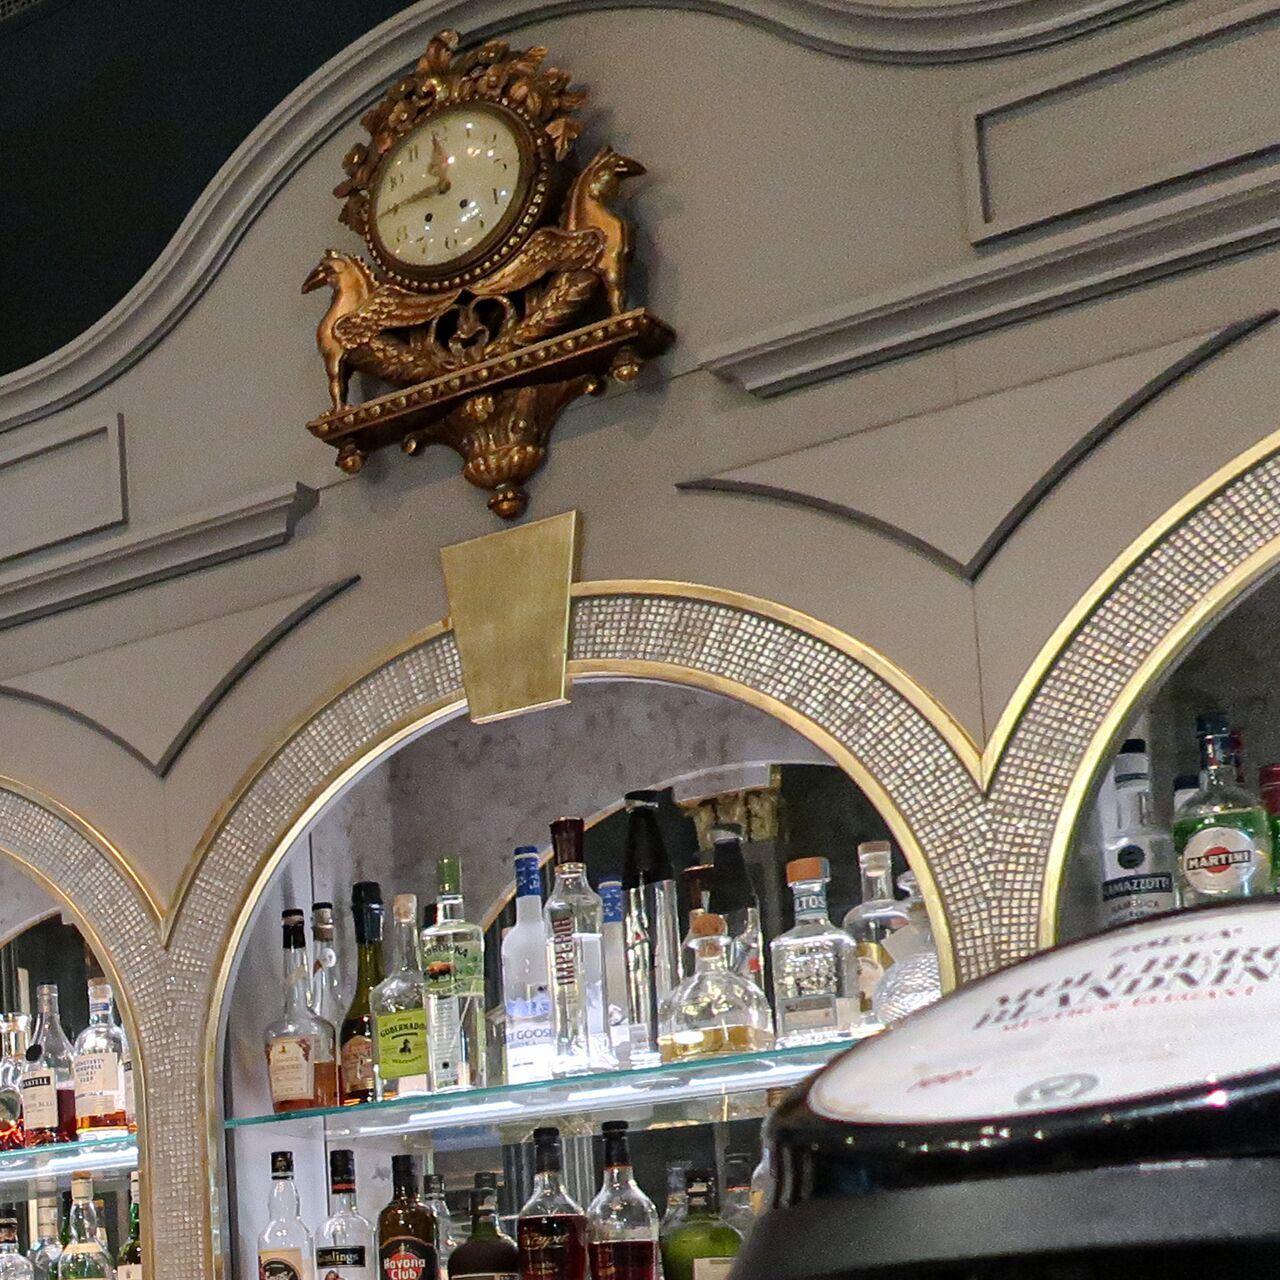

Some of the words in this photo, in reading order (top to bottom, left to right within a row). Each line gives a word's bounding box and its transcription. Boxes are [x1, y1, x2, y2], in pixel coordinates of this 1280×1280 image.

[1189, 852, 1249, 869] MARTINI
[383, 1258, 426, 1269] Havana
[392, 1268, 417, 1280] Club
